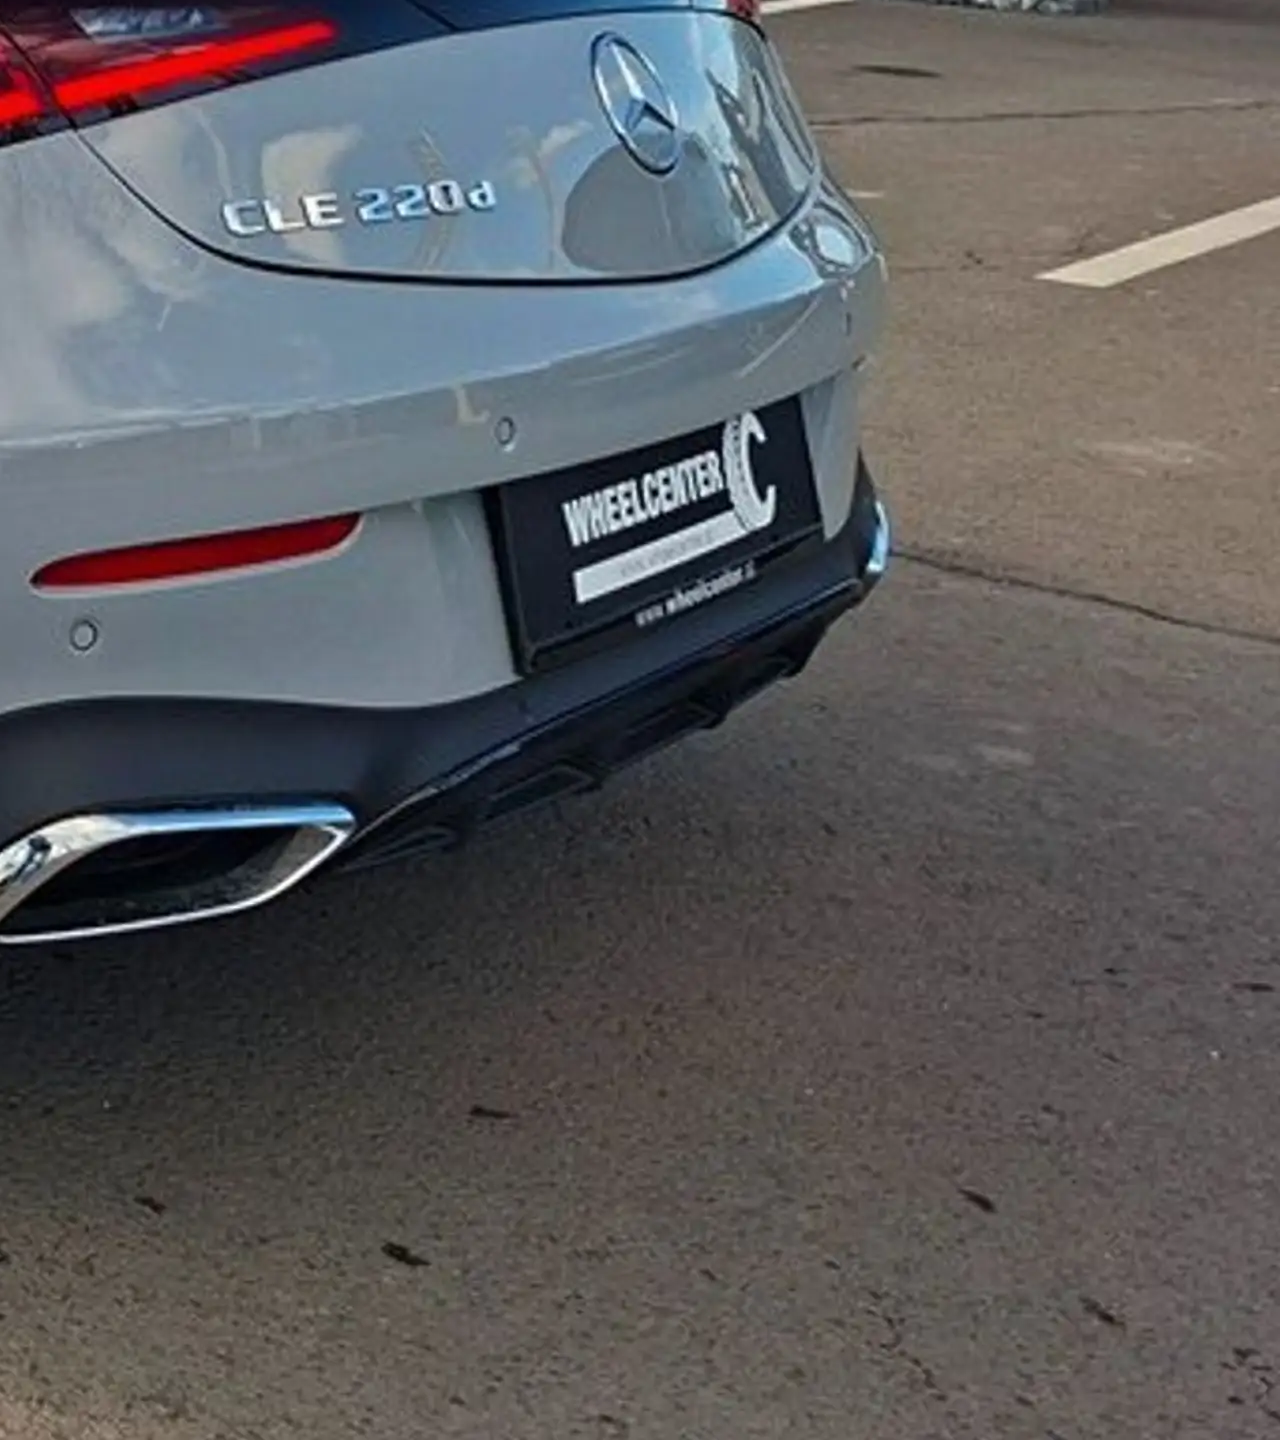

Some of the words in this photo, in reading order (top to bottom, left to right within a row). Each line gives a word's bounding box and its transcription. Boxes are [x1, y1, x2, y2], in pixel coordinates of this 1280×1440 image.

[221, 190, 345, 238] CLE
[355, 178, 498, 224] 220d
[561, 448, 724, 548] WHEELCENTER
